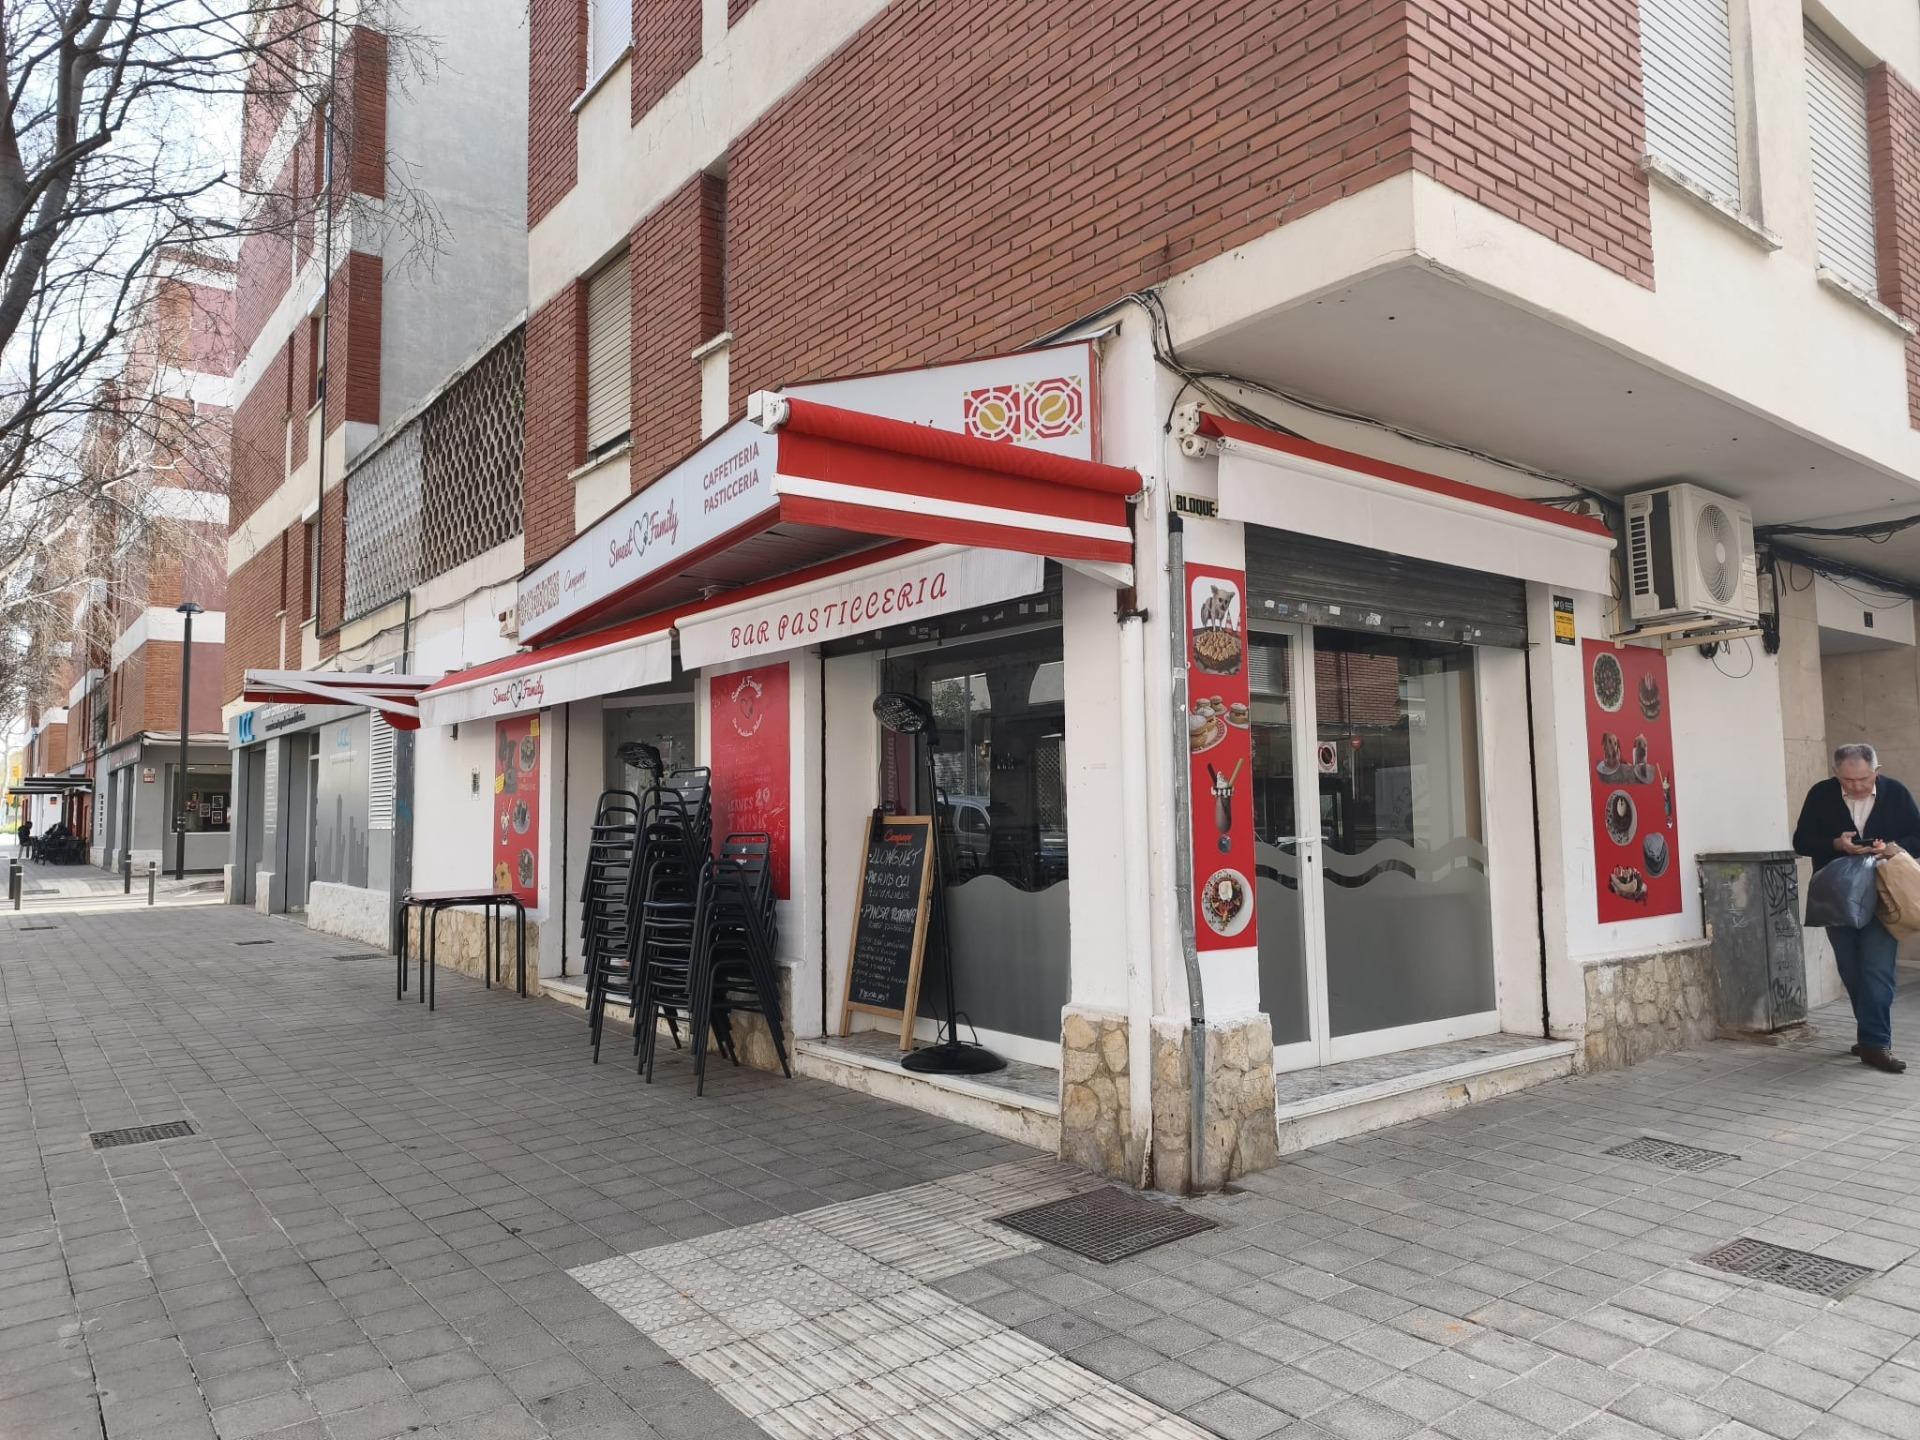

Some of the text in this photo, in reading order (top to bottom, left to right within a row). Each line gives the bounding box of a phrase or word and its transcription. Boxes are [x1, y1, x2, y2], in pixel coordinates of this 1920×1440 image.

[703, 441, 760, 490] CAFFETTERIA
[704, 468, 760, 515] PASTICCERIA
[1176, 494, 1215, 517] BLOQUE
[609, 497, 679, 568] Sweet Family
[731, 572, 947, 648] BAR PASTICCERIA
[493, 674, 544, 705] Sweet Family
